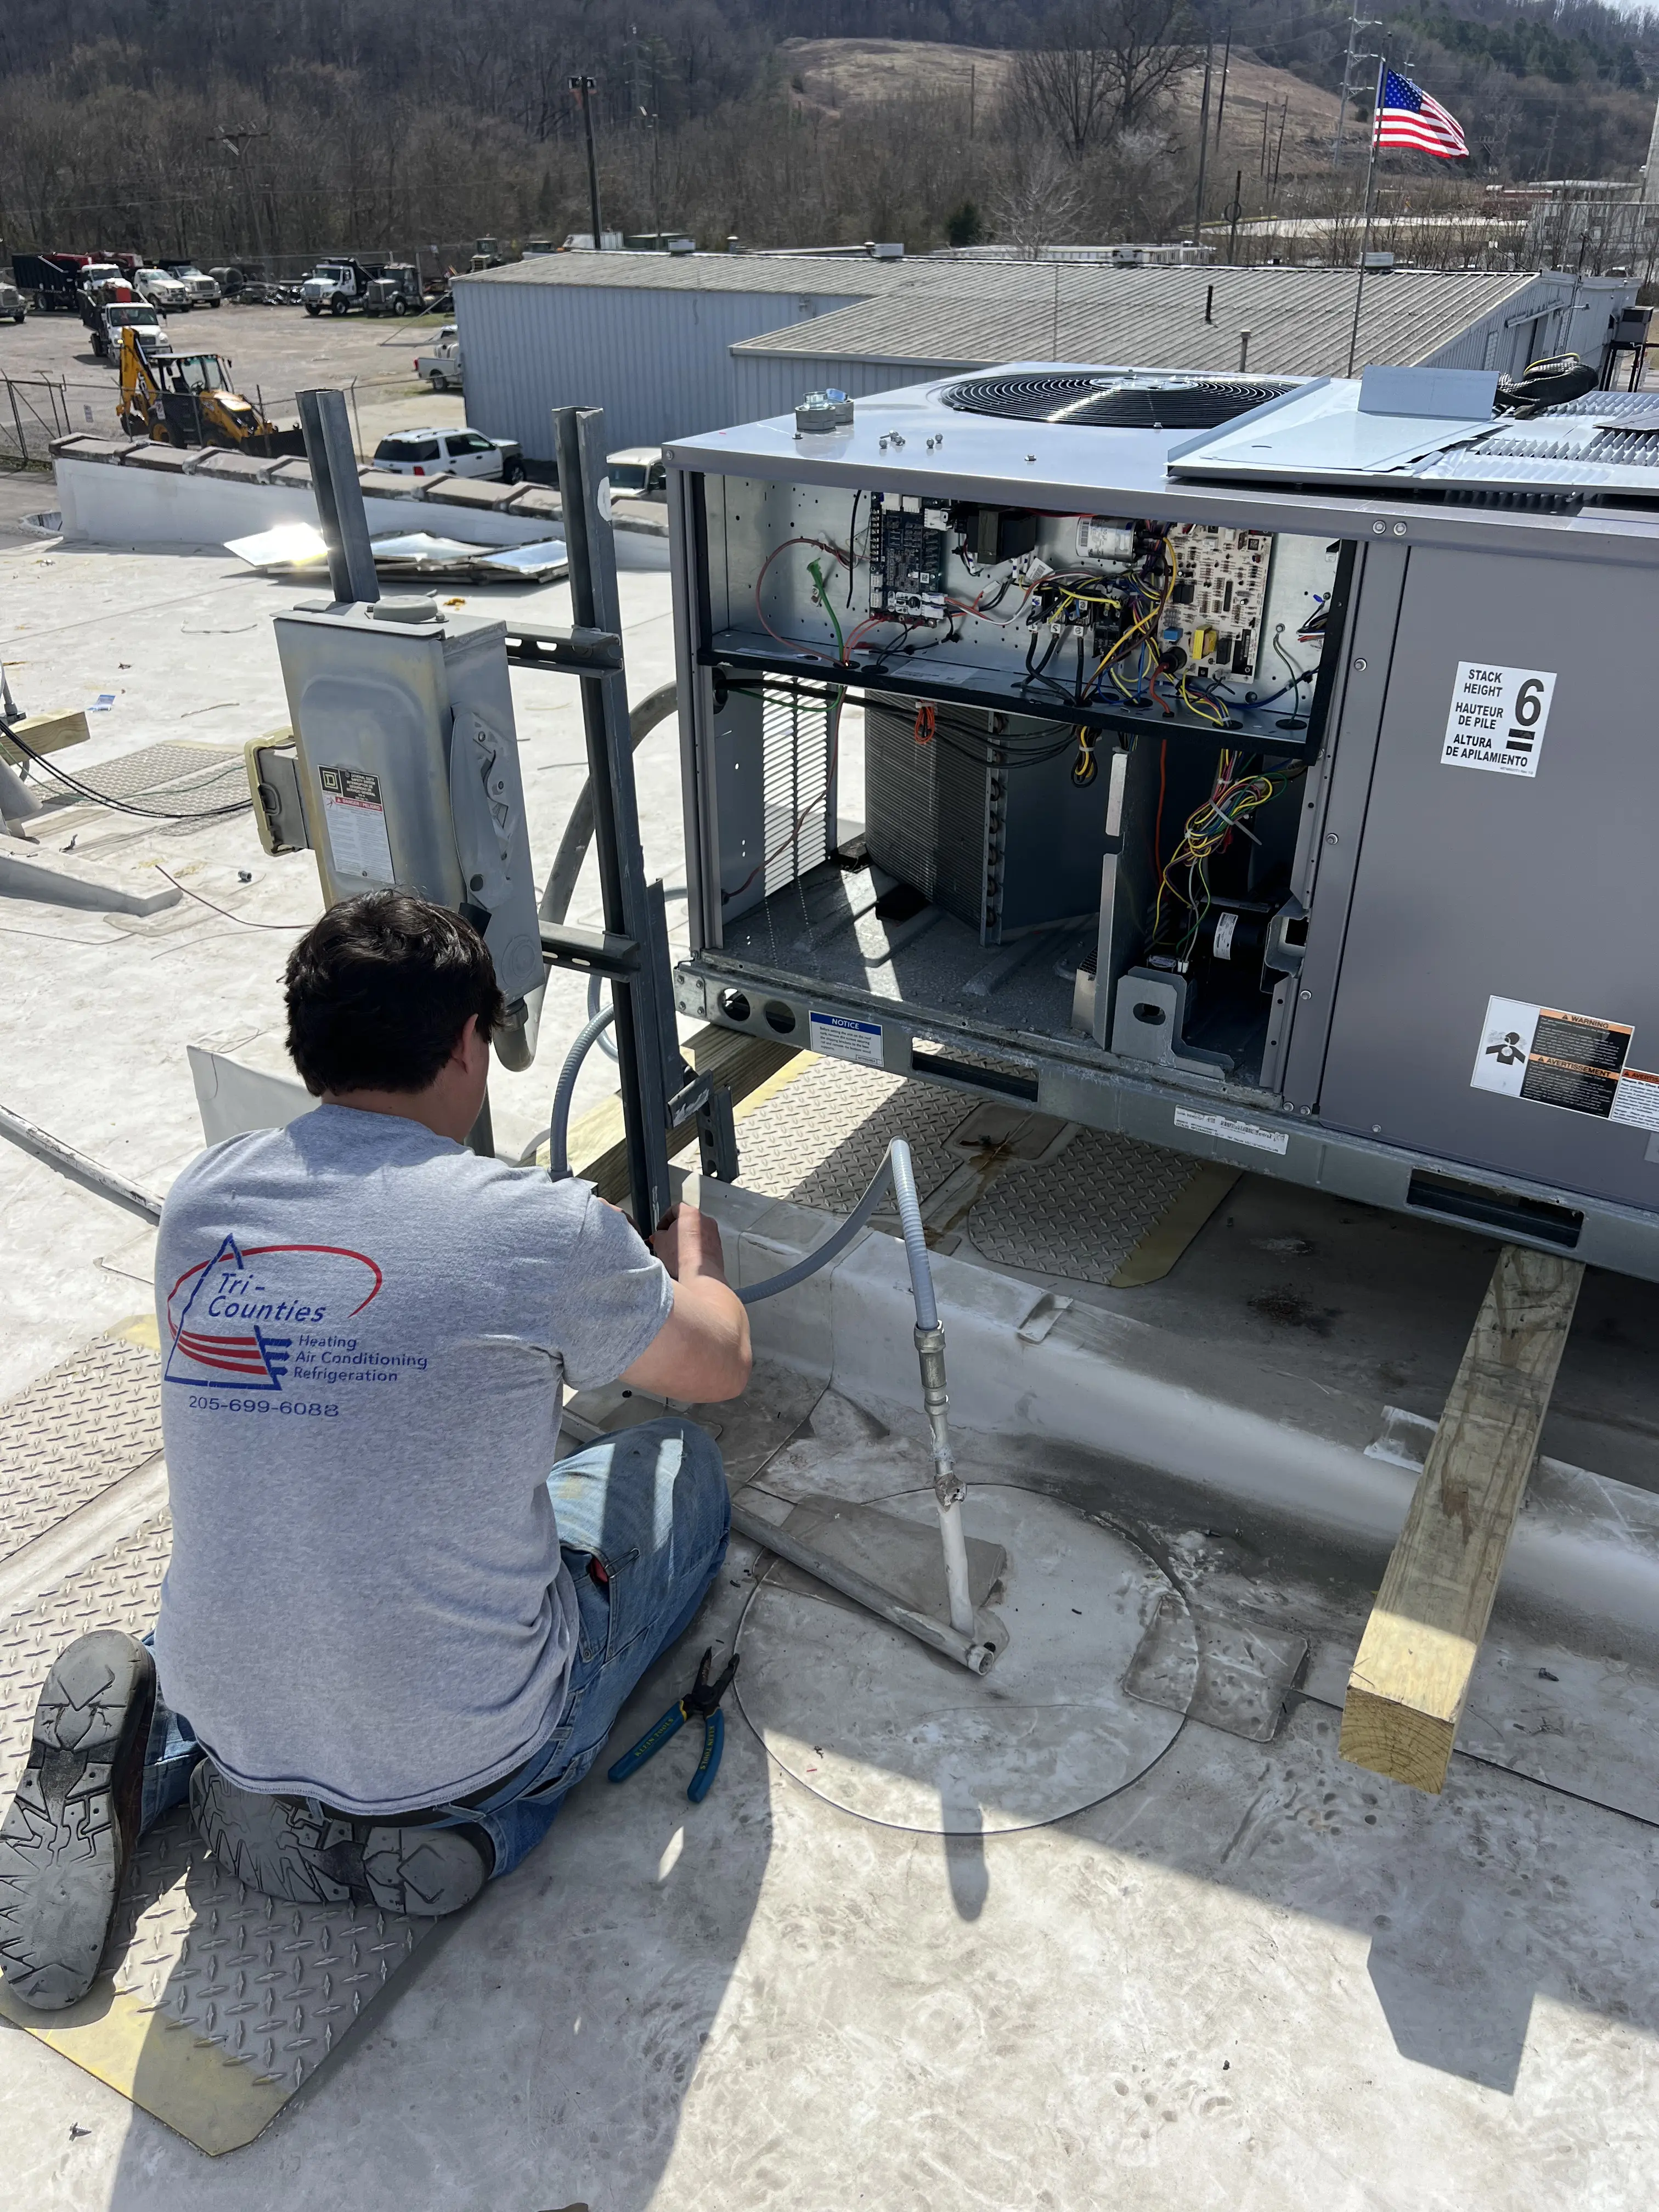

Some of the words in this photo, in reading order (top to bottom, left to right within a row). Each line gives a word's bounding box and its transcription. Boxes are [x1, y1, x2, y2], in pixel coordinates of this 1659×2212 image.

[1468, 669, 1503, 683] STACK
[1463, 683, 1503, 697] HEIGHT
[1455, 702, 1503, 718] HAUTEUR
[1515, 678, 1544, 726] 6
[1458, 715, 1472, 726] DE
[1474, 718, 1497, 730] PILE
[1453, 733, 1492, 749] ALTURA
[1446, 746, 1458, 757] DE
[1460, 748, 1527, 767] APILAMIENTO
[832, 1018, 860, 1029] NOTICE
[1571, 1015, 1609, 1029] WARNING
[1547, 1058, 1611, 1077] AVERTISSEMENT
[208, 1295, 327, 1323] Counties
[298, 1334, 358, 1351] Heating
[295, 1352, 316, 1363] Air
[320, 1352, 428, 1370] Conditioning
[294, 1367, 398, 1383] Refrigeration
[189, 1396, 339, 1417] 205-699-6088
[635, 1738, 655, 1757] KLEIN
[653, 1718, 674, 1737] TOOLS
[699, 1748, 712, 1770] TOOLS
